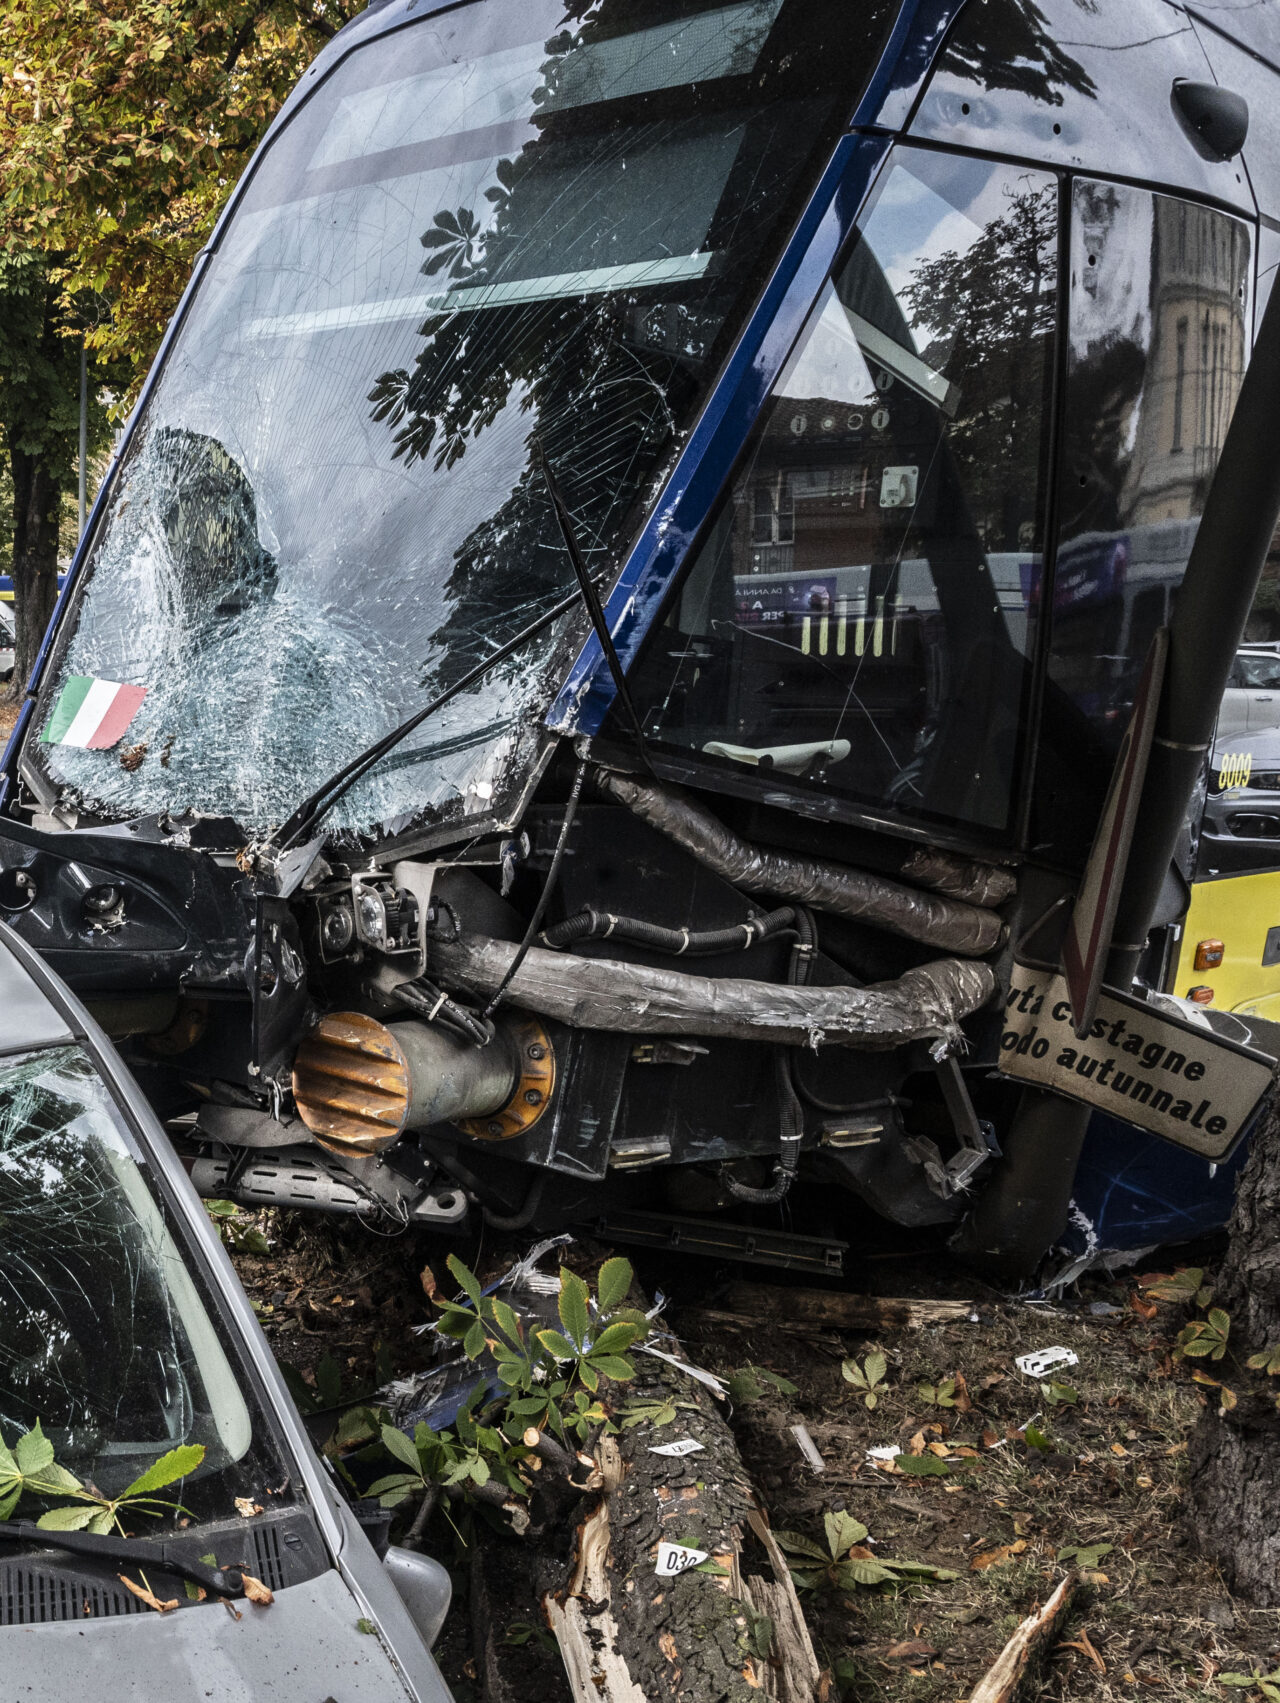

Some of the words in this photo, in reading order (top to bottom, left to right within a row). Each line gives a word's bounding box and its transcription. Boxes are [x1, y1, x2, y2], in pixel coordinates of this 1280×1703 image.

[1218, 752, 1252, 790] 8009
[1000, 1026, 1050, 1059] odo
[1056, 1047, 1228, 1136] autunnale
[1051, 1001, 1206, 1082] cstagne
